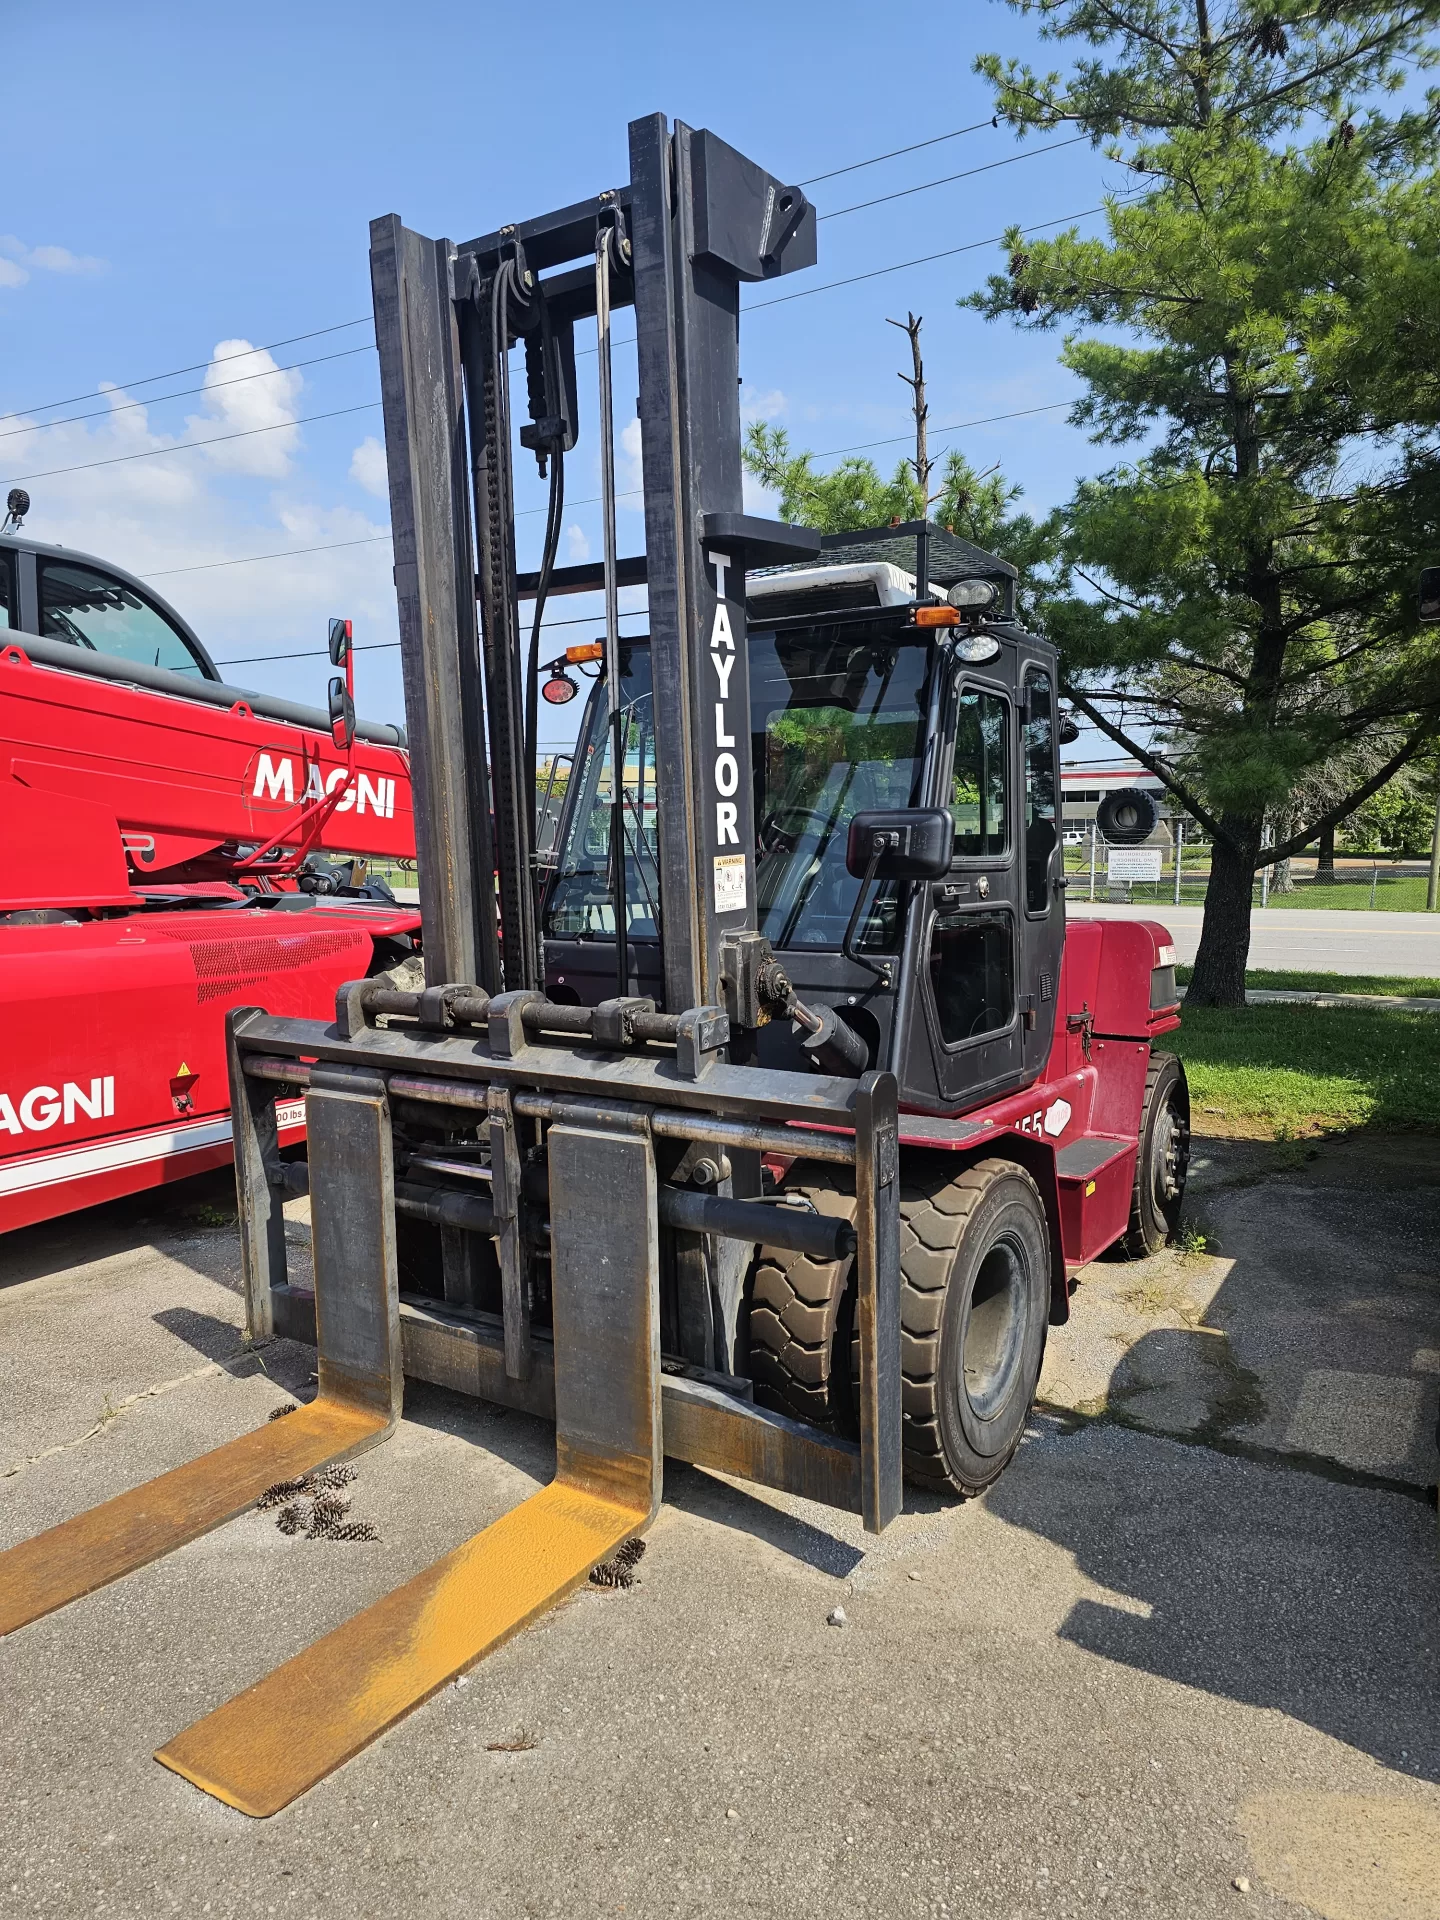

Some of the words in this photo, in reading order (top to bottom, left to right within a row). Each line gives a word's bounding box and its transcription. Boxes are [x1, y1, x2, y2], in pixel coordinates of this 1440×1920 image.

[708, 550, 740, 846] TAYLOR
[252, 753, 395, 819] MAGNI
[721, 857, 743, 866] WARNING
[289, 1109, 302, 1120] lbs
